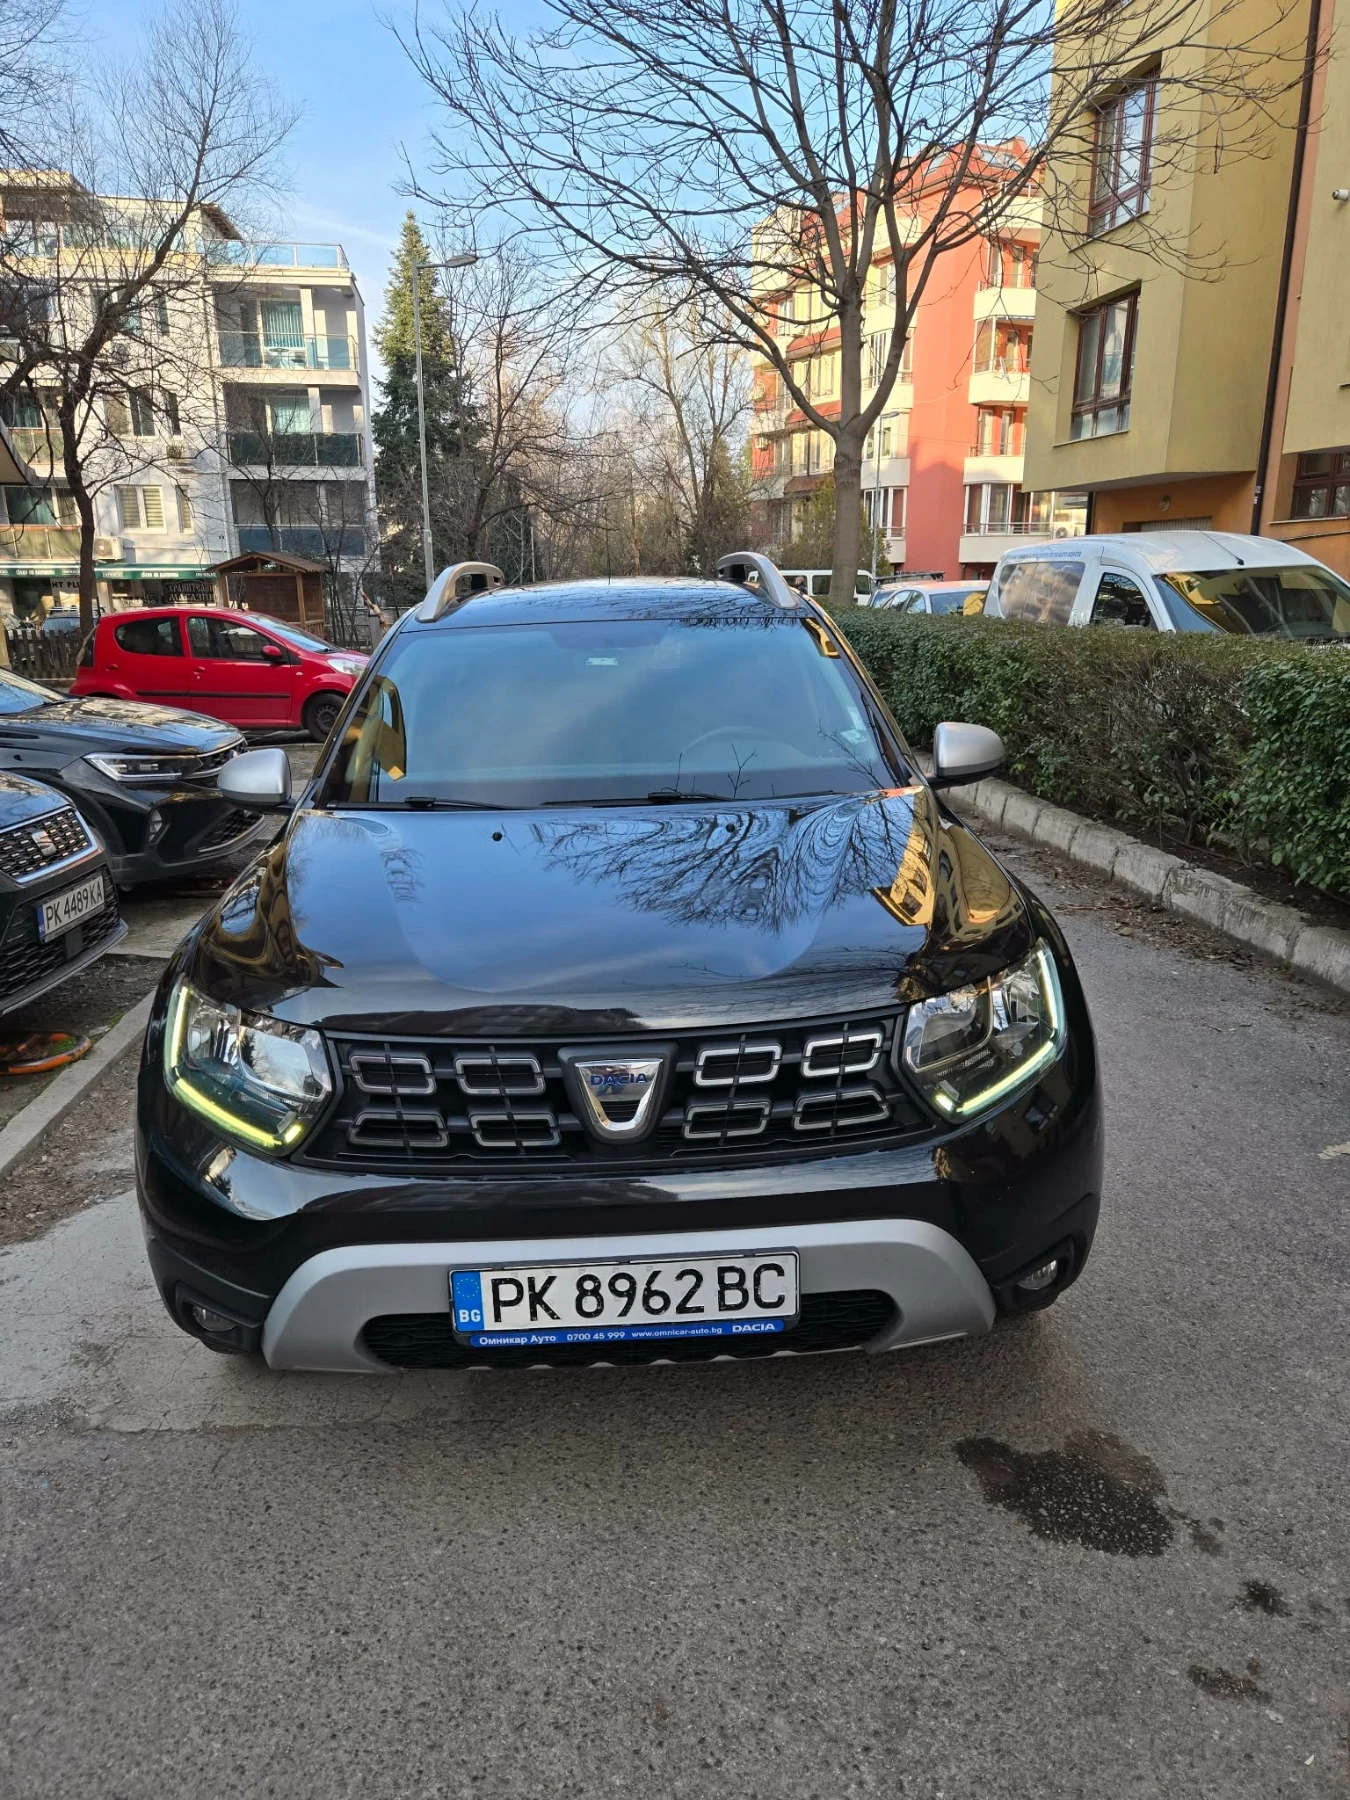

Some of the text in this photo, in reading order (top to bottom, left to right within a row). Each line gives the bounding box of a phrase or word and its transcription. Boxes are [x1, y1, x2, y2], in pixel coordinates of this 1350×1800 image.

[590, 1073, 648, 1086] DACIA
[491, 1263, 786, 1323] PK 8962 BC
[459, 1308, 481, 1323] BG
[479, 1323, 776, 1345] Омникар Ауто 0700 45 999 www.omnicar-auto.bg DACIA
